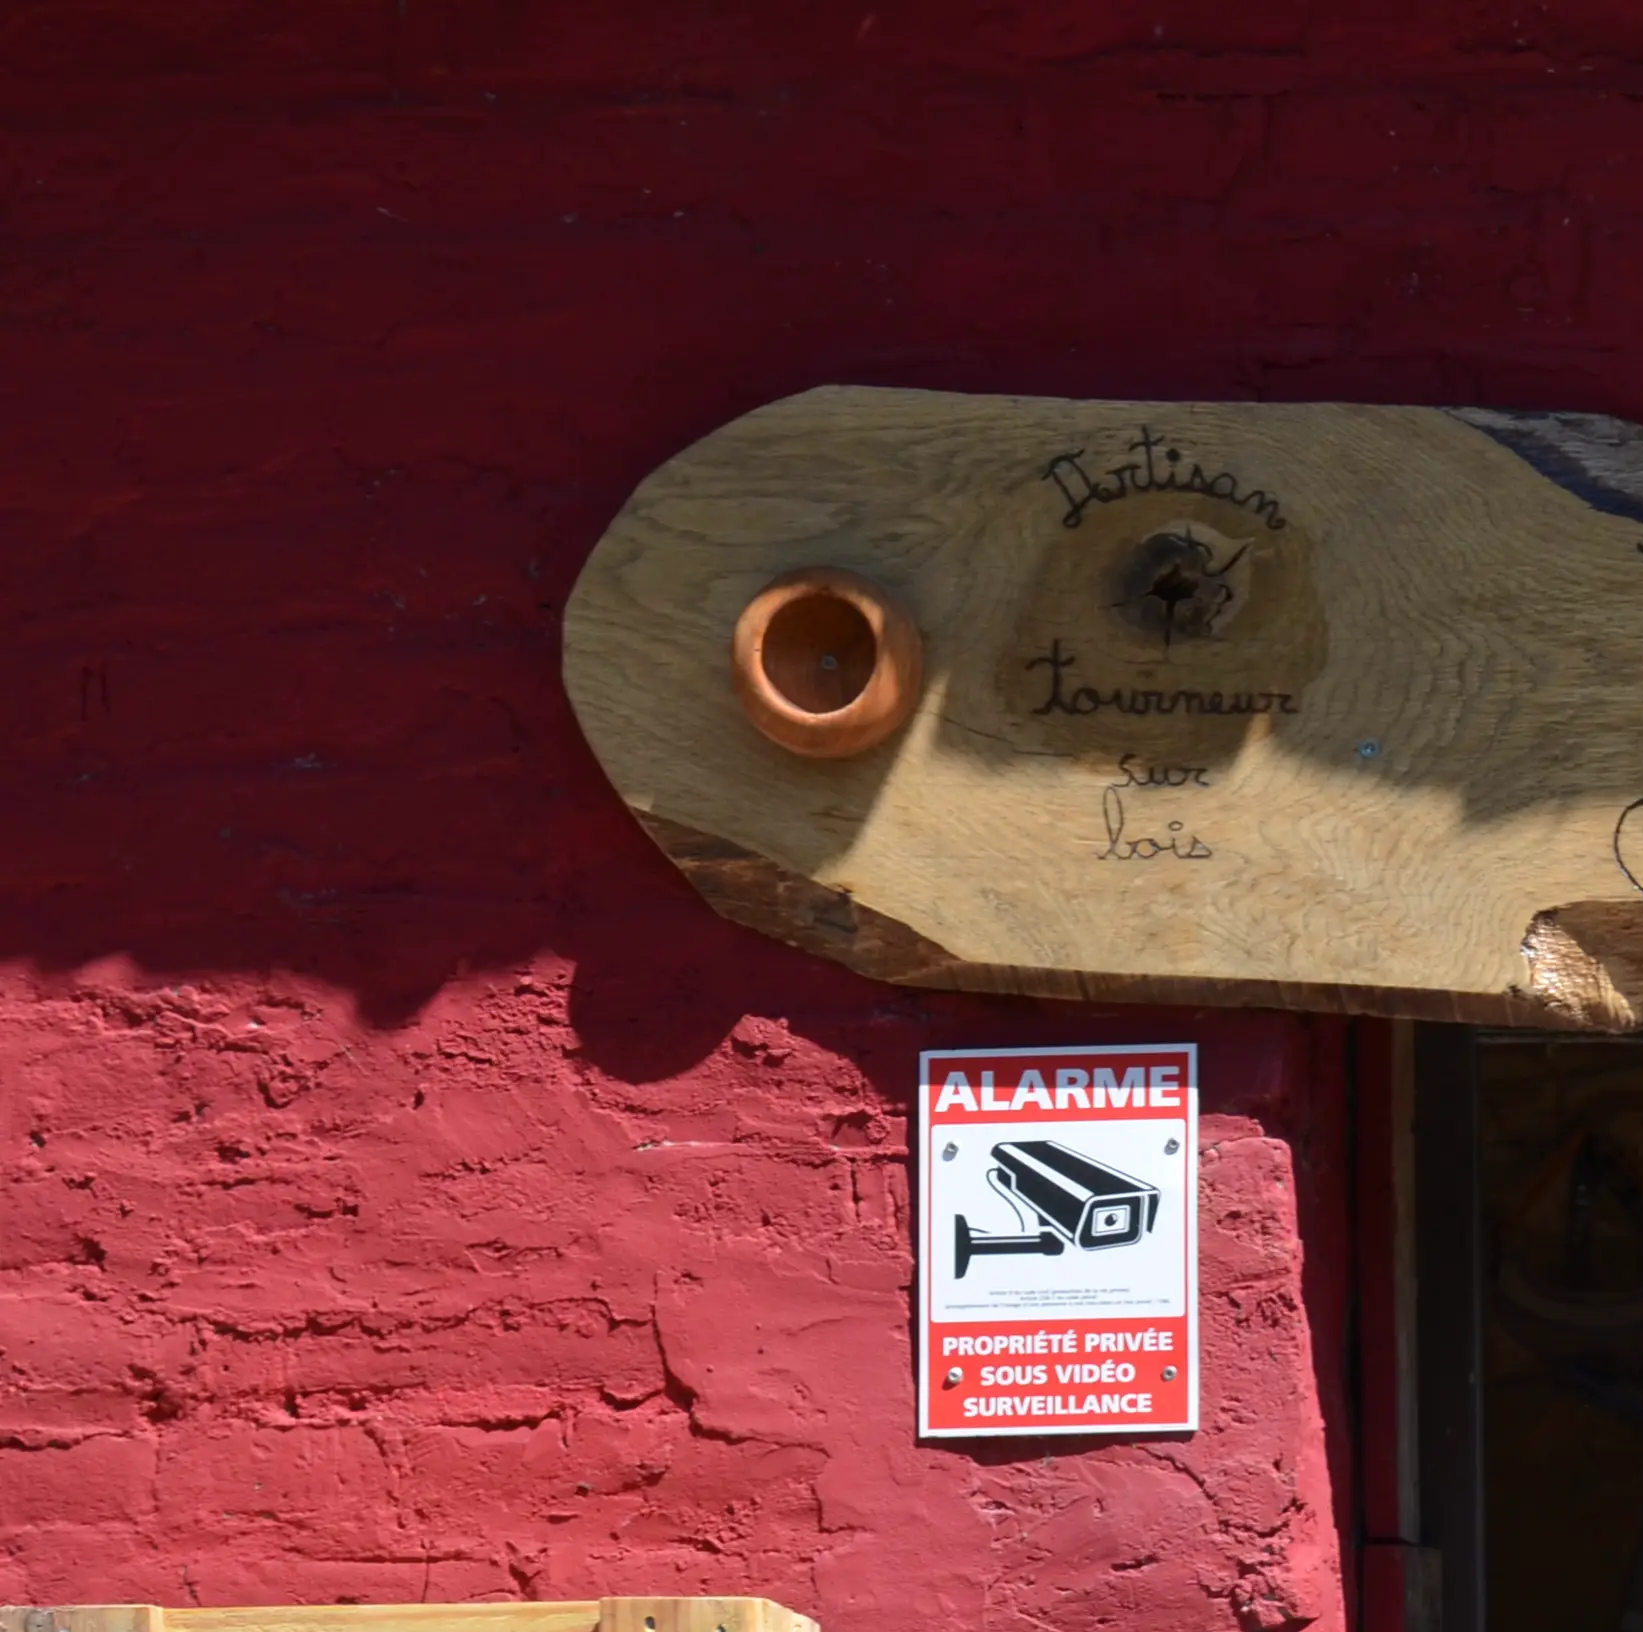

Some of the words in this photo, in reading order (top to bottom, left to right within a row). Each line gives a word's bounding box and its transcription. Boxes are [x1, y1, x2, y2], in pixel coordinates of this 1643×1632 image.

[1040, 425, 1286, 528] Artisan
[1024, 638, 1298, 715] tourneur
[1096, 785, 1213, 861] bois
[934, 1065, 1181, 1113] ALARME
[942, 1329, 1077, 1357] PROPRIÉTÉ
[1084, 1326, 1174, 1353] PRIVÉE
[980, 1364, 1048, 1386] SOUS
[1055, 1358, 1136, 1384] VIDÉO
[962, 1393, 1152, 1418] SURVEILLANCE
